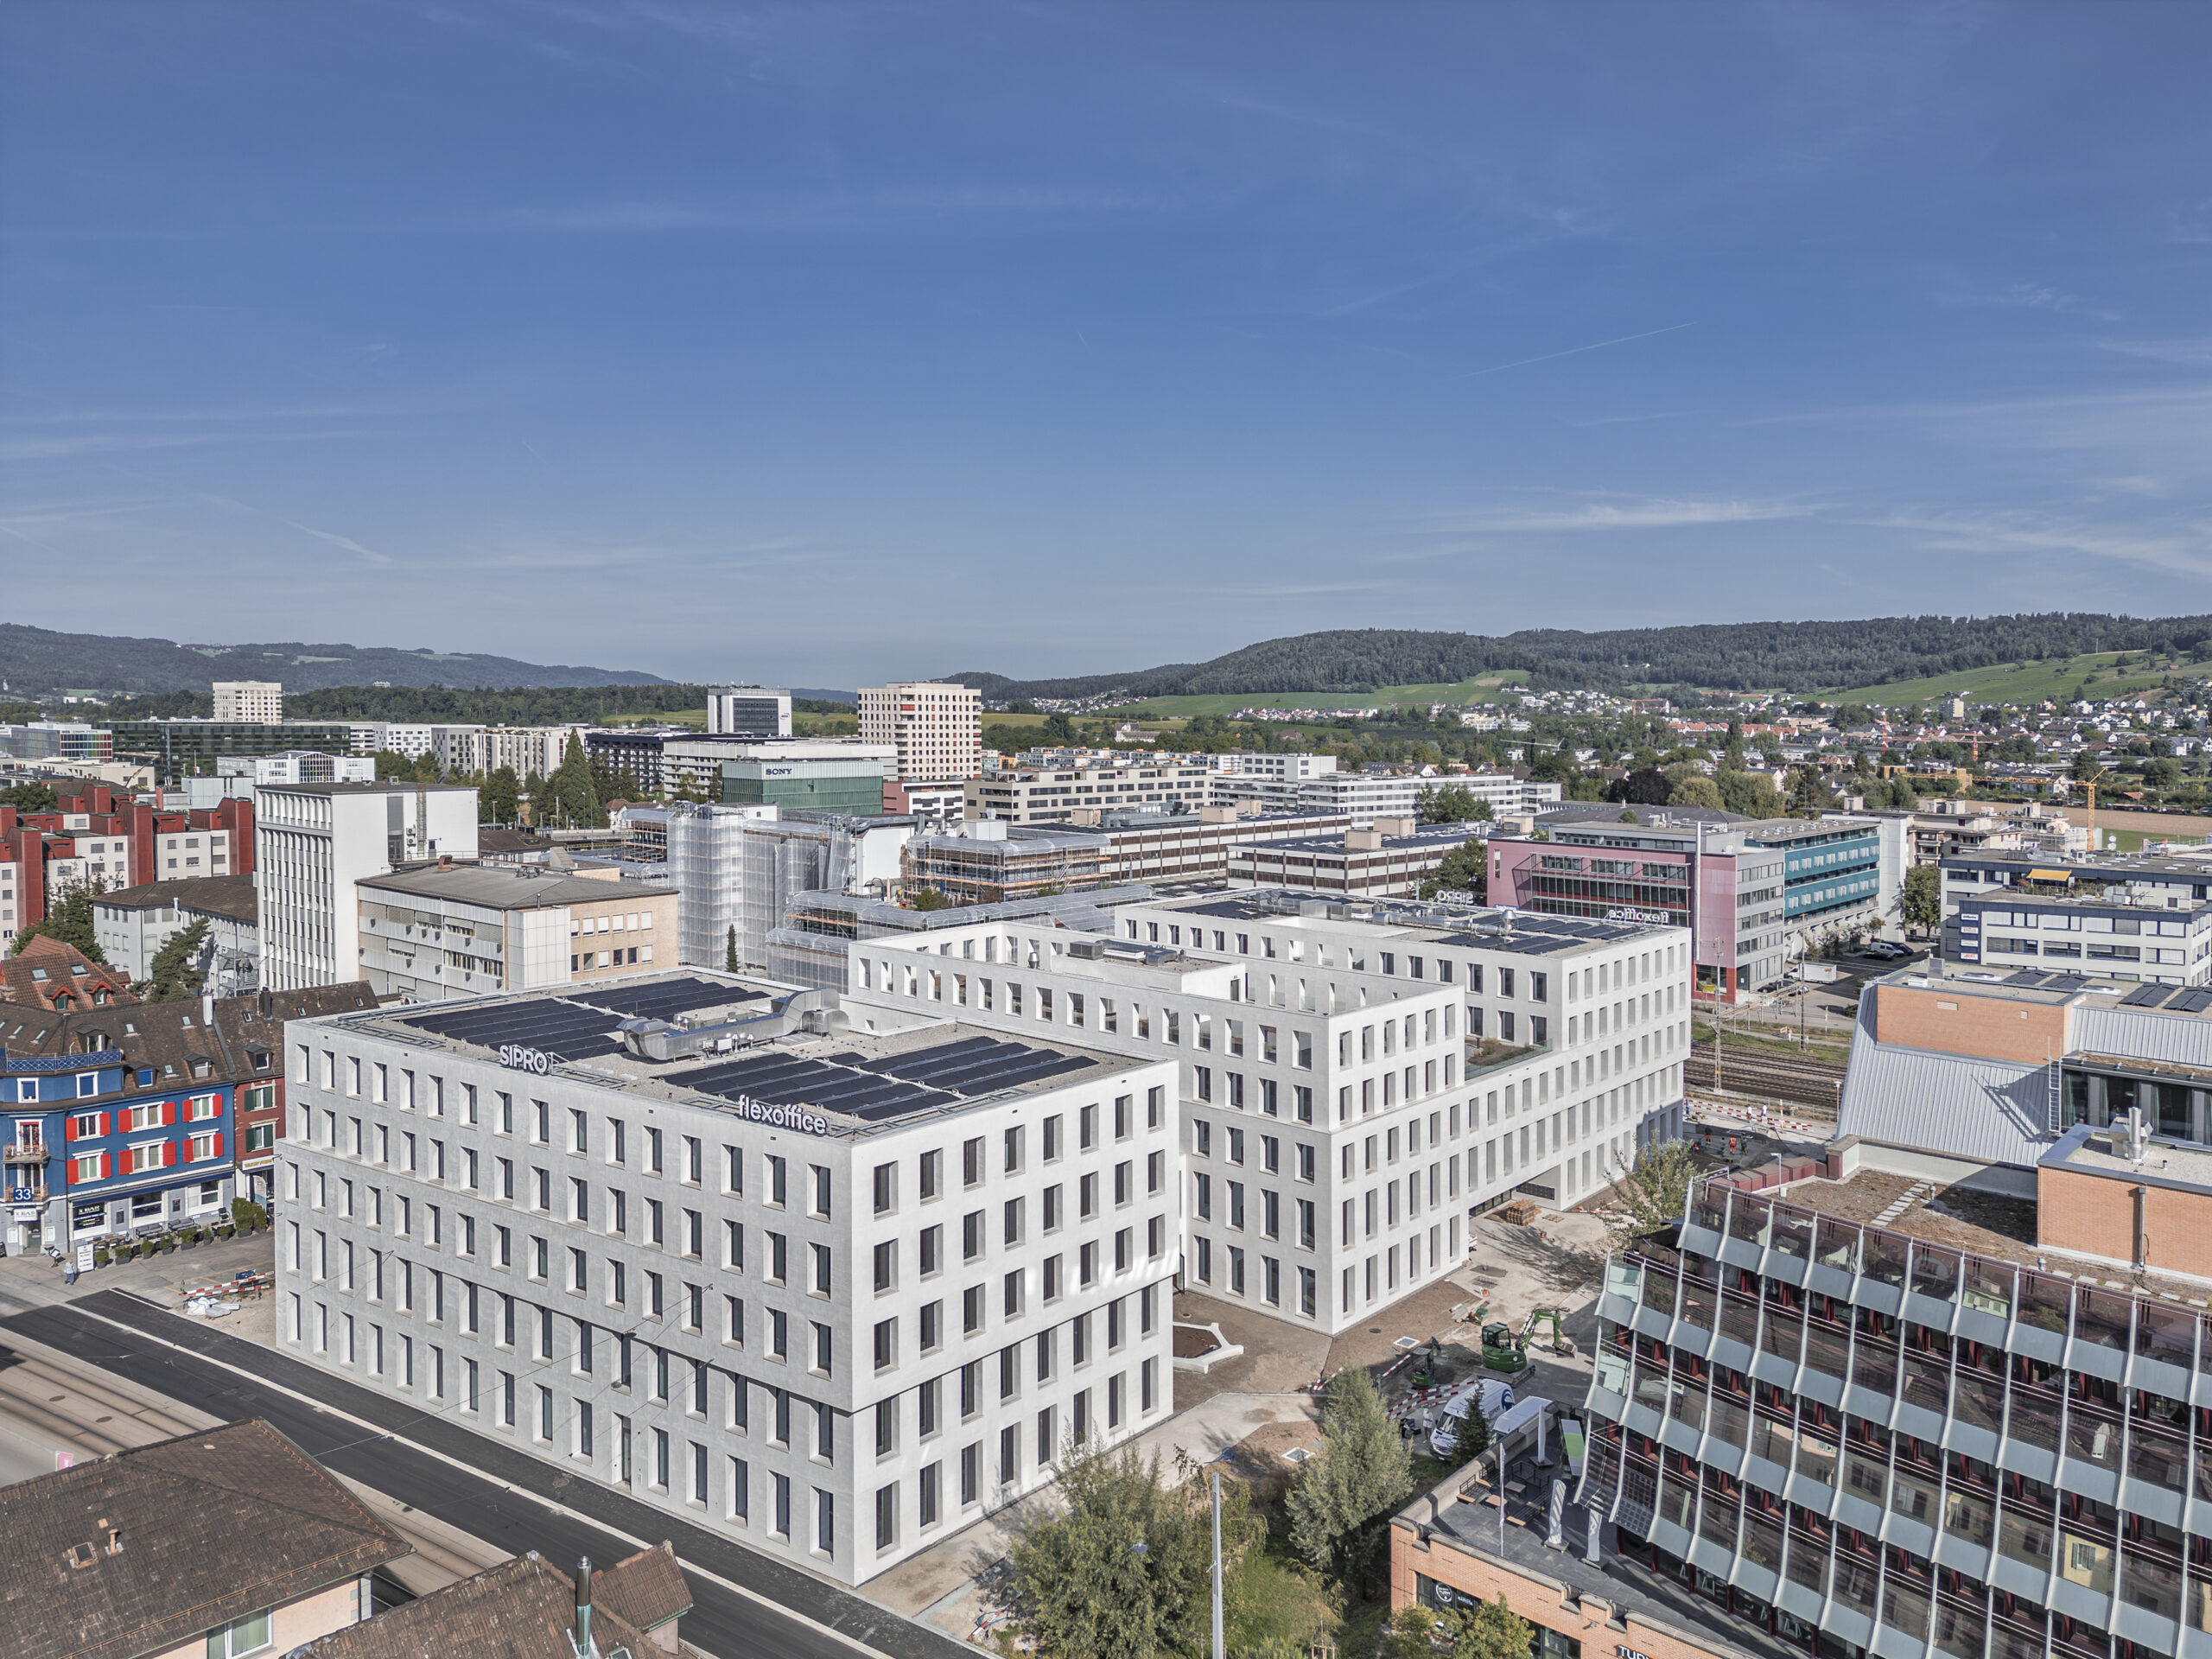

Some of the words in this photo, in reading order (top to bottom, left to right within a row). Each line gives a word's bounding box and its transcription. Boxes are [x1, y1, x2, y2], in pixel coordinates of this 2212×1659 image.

[499, 1045, 548, 1073] SIPRO
[739, 1094, 827, 1135] flexoffice
[15, 1188, 32, 1200] 33
